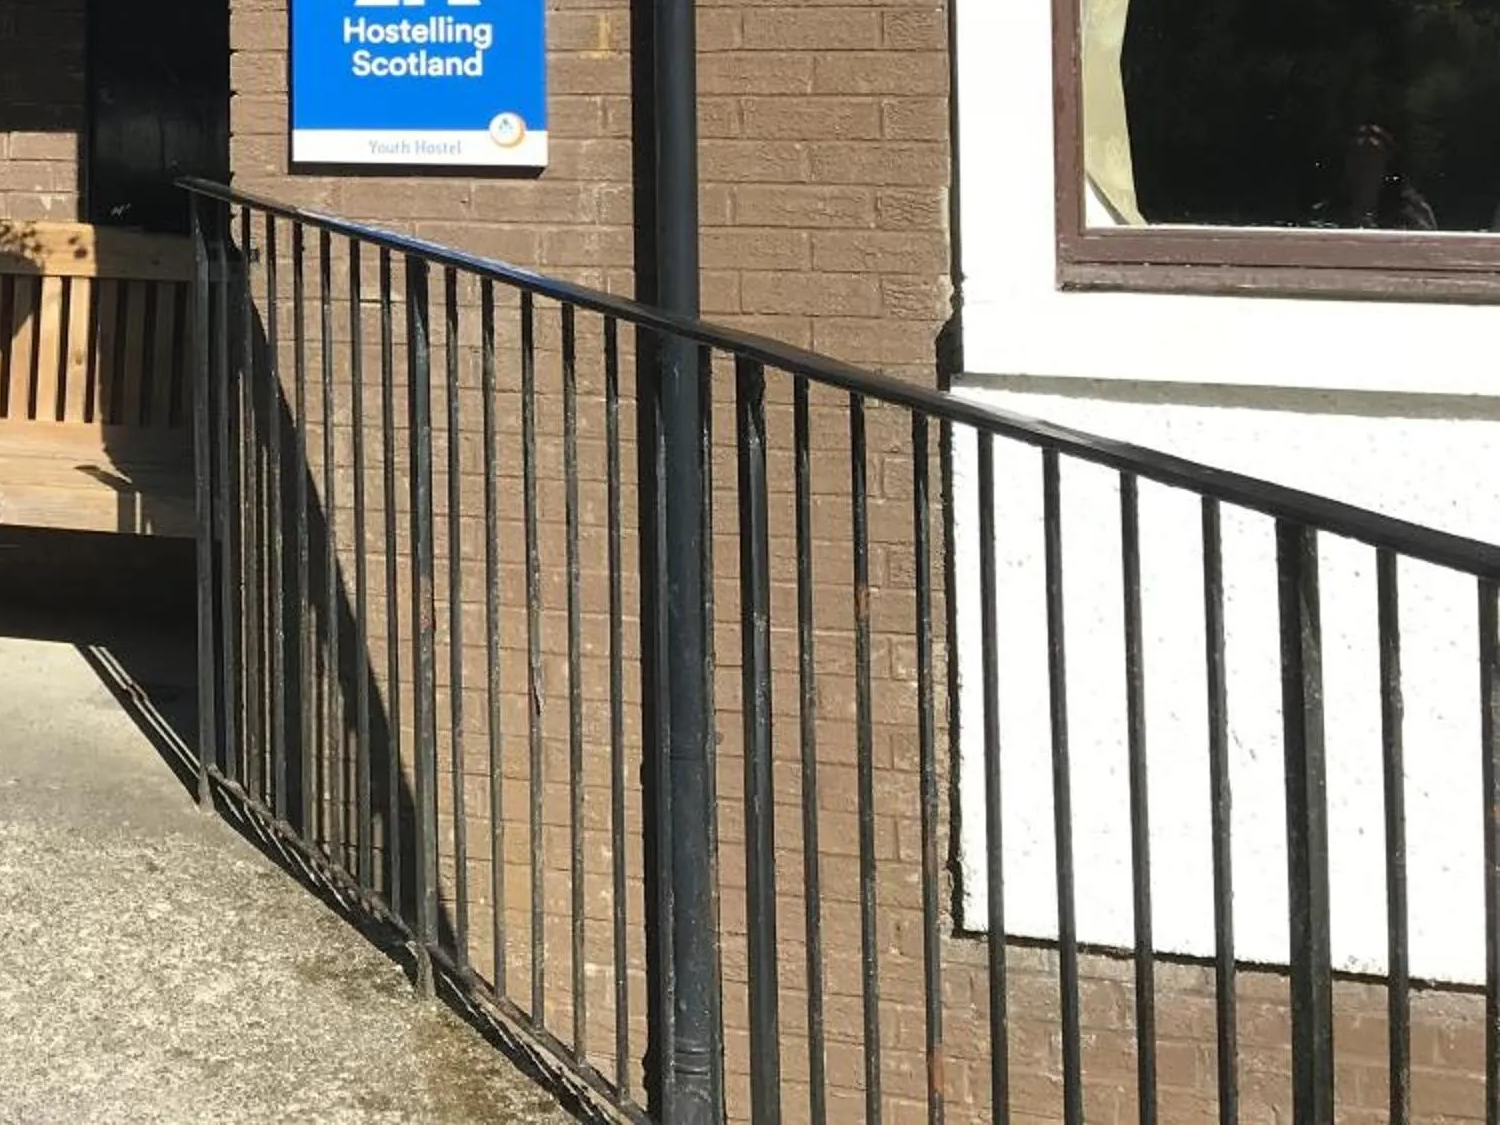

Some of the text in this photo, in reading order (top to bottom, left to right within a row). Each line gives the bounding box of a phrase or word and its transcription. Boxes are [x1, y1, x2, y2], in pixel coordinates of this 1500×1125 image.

[343, 16, 493, 50] Hostelling
[352, 49, 483, 76] Scotland
[368, 139, 462, 155] Youth Hostel
